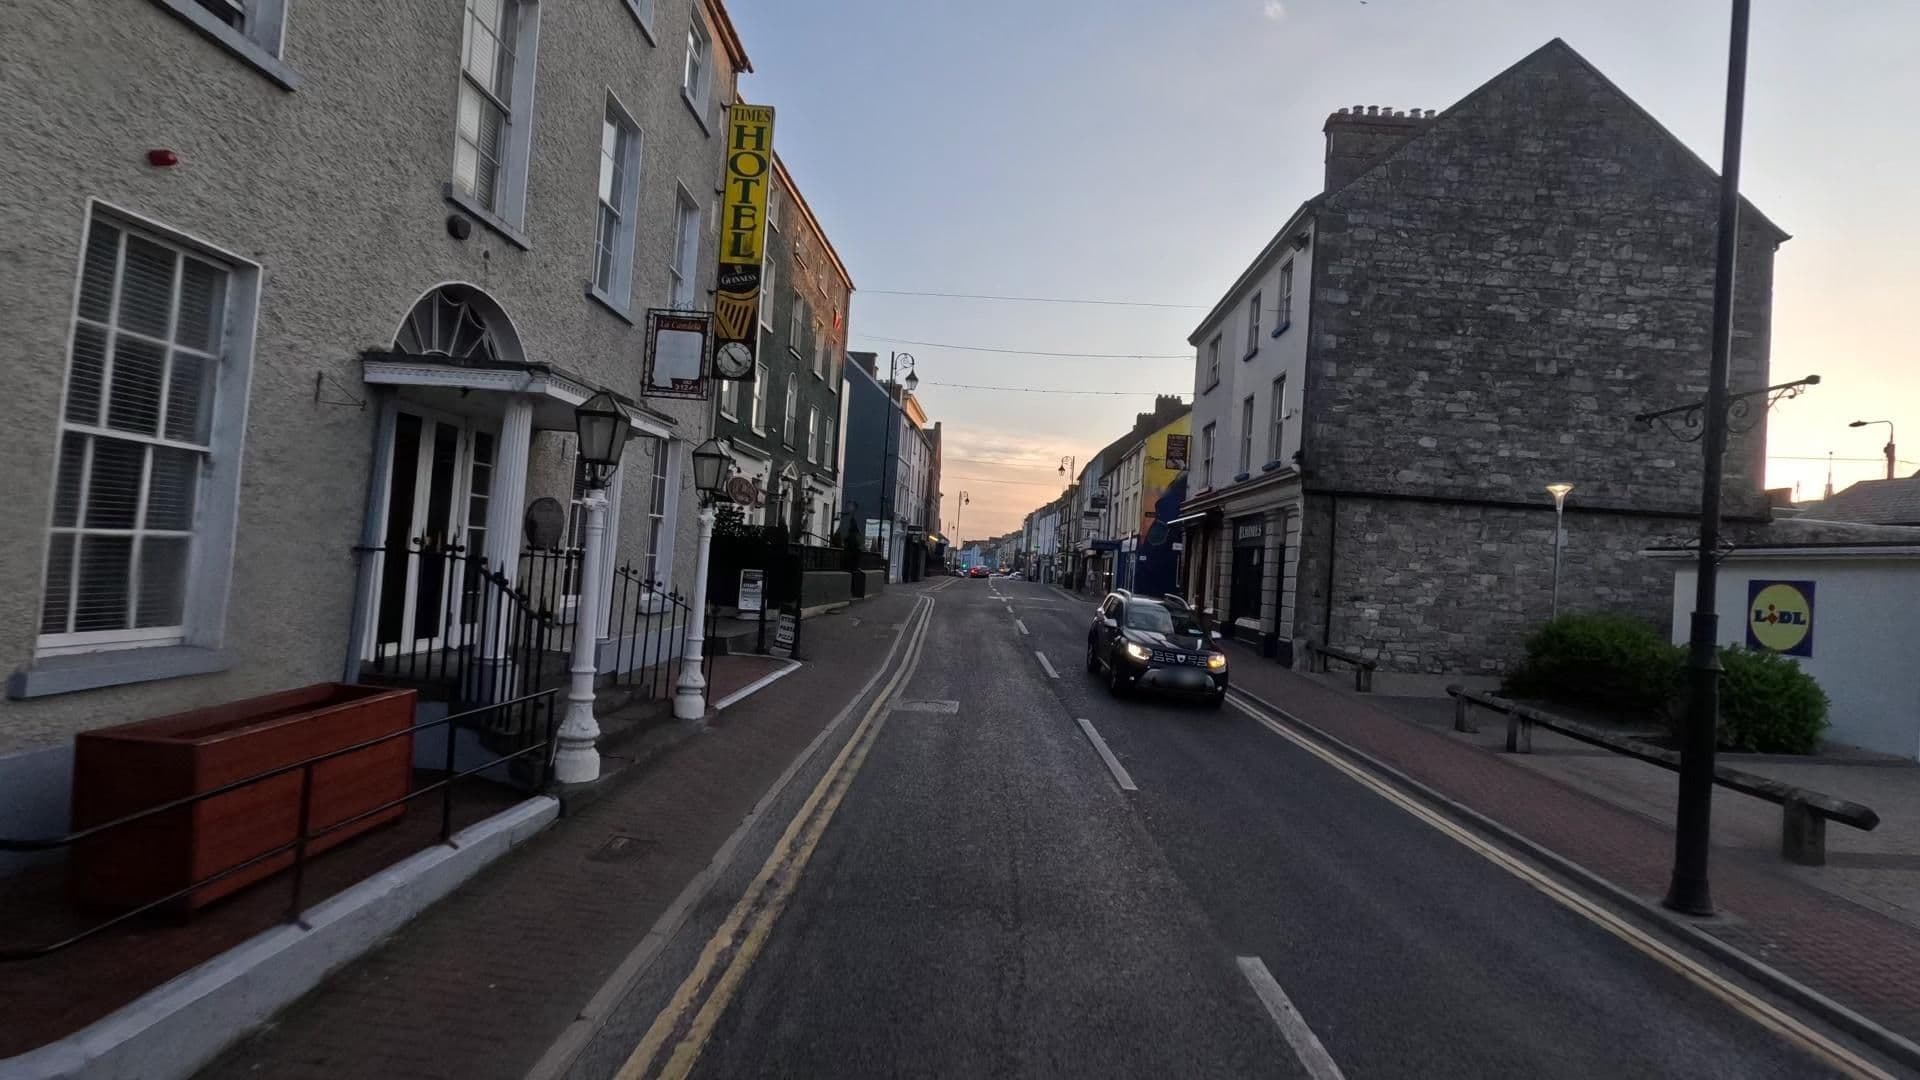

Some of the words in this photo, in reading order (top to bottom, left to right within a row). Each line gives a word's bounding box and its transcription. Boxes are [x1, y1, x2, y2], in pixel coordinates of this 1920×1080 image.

[733, 107, 771, 122] TIMES
[729, 124, 767, 258] HOTEL
[720, 273, 758, 285] GUINNESS
[1754, 604, 1806, 626] LIDL
